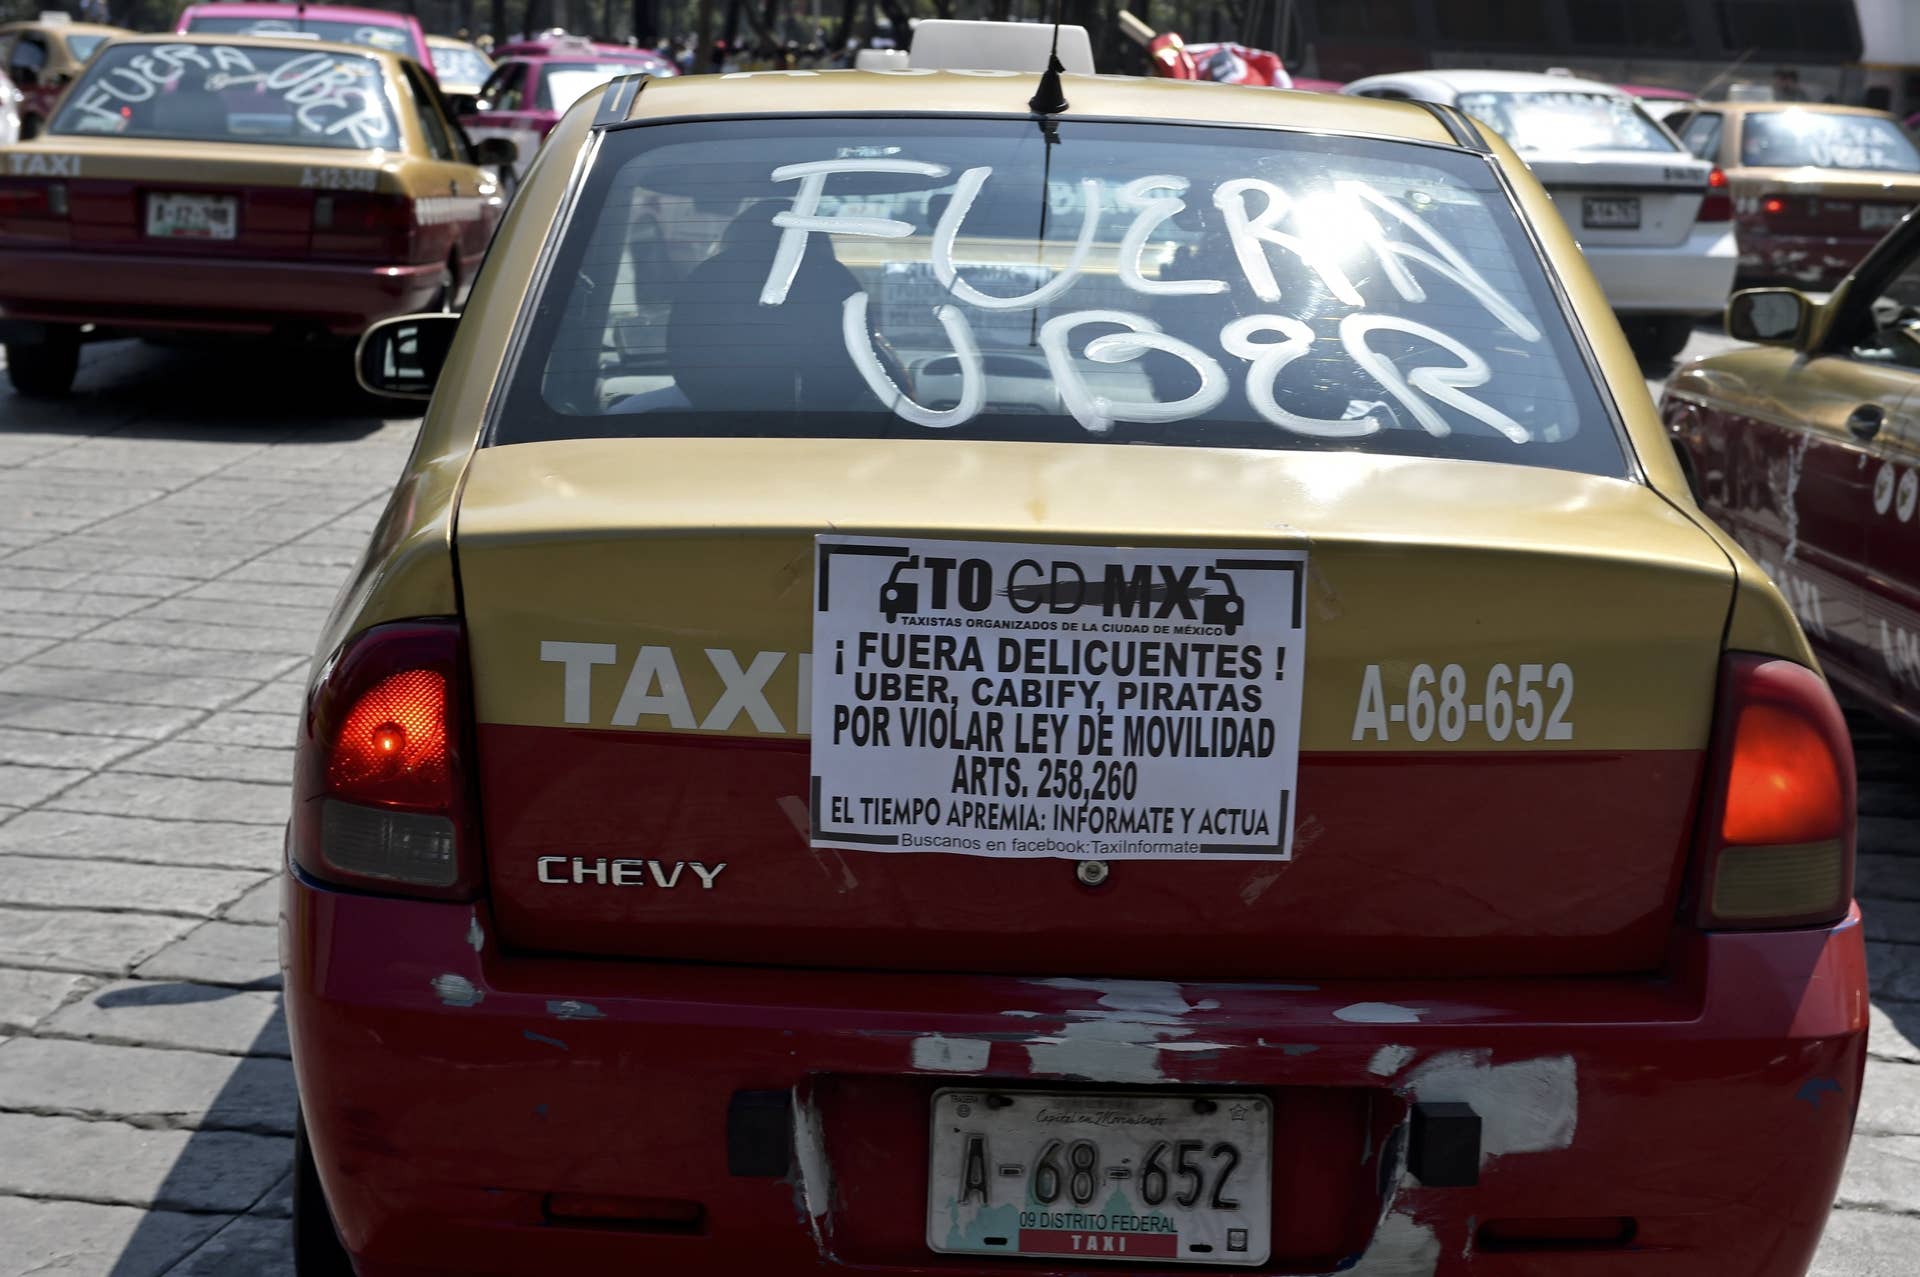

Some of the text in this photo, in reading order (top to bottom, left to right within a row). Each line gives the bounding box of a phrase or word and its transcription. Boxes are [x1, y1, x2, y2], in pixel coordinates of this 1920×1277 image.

[75, 43, 256, 125] FUERA
[9, 154, 80, 176] TAXI
[759, 159, 1542, 342] FUERA
[843, 292, 1530, 444] UBER
[924, 557, 993, 612] TO
[1103, 564, 1200, 620] MX
[902, 616, 1223, 637] TAXISTAS ORGANIZADOS DE LA CIUDAD DE MÉXICO
[858, 632, 984, 672] FUERA
[998, 637, 1262, 680] DELICUENTES
[1275, 646, 1287, 681] !
[855, 672, 1263, 715] UBER, CABIFY, PIRATAS
[1351, 663, 1575, 742] A-68-652
[833, 704, 1275, 759] POR VIOLAR LEY DE MOVILIDAD
[951, 755, 1138, 808] ARTS. 258,260
[831, 796, 1270, 836] EL TIEMPO APREMIA: INFORMATE Y ACTUA
[902, 833, 981, 850] Buscanos
[987, 840, 1007, 851] en
[537, 856, 727, 889] CHEVY
[957, 1133, 1241, 1210] A-68-652
[1019, 1211, 1179, 1233] 09 DISTRITO FEDERAL
[1071, 1235, 1127, 1252] TAXI
